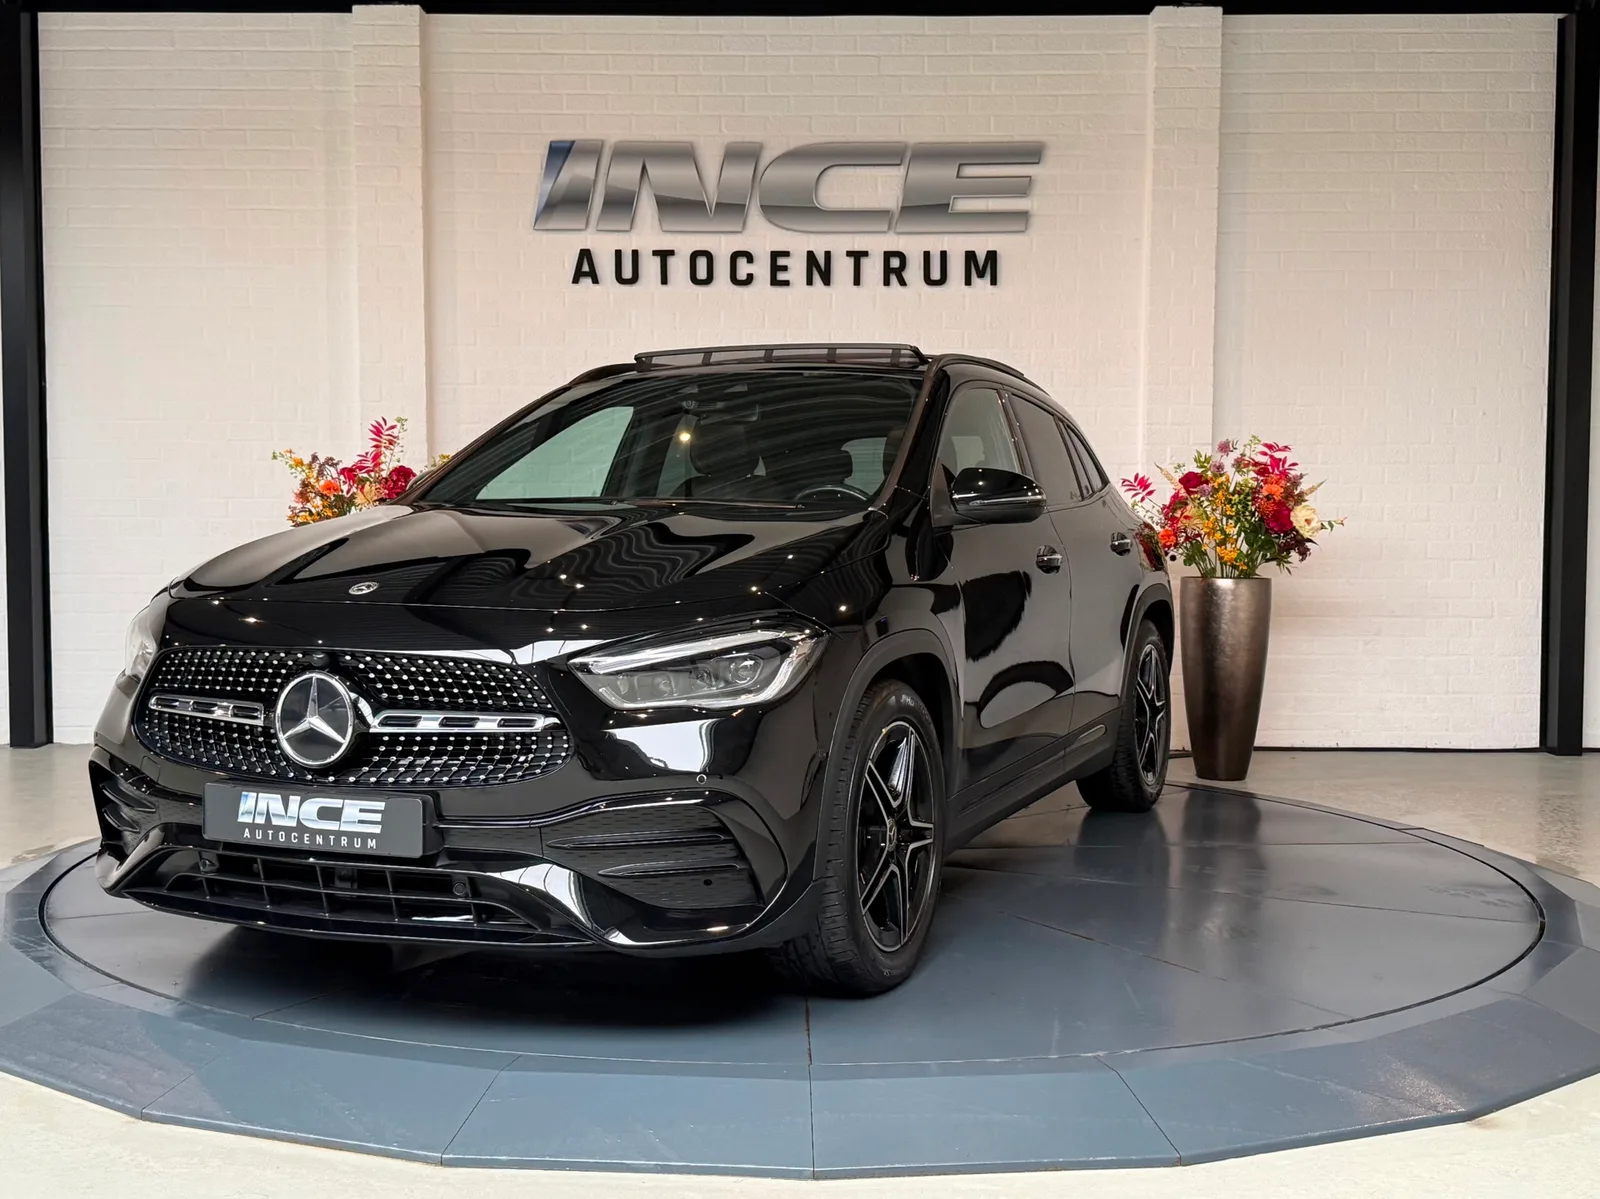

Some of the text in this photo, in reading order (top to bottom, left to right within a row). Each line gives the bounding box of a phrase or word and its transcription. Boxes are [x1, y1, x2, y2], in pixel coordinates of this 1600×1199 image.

[533, 140, 1045, 233] INCE
[572, 248, 998, 286] AUTOCENTRUM
[237, 791, 386, 834] INCE
[243, 828, 377, 849] AUTOCENTRUM
